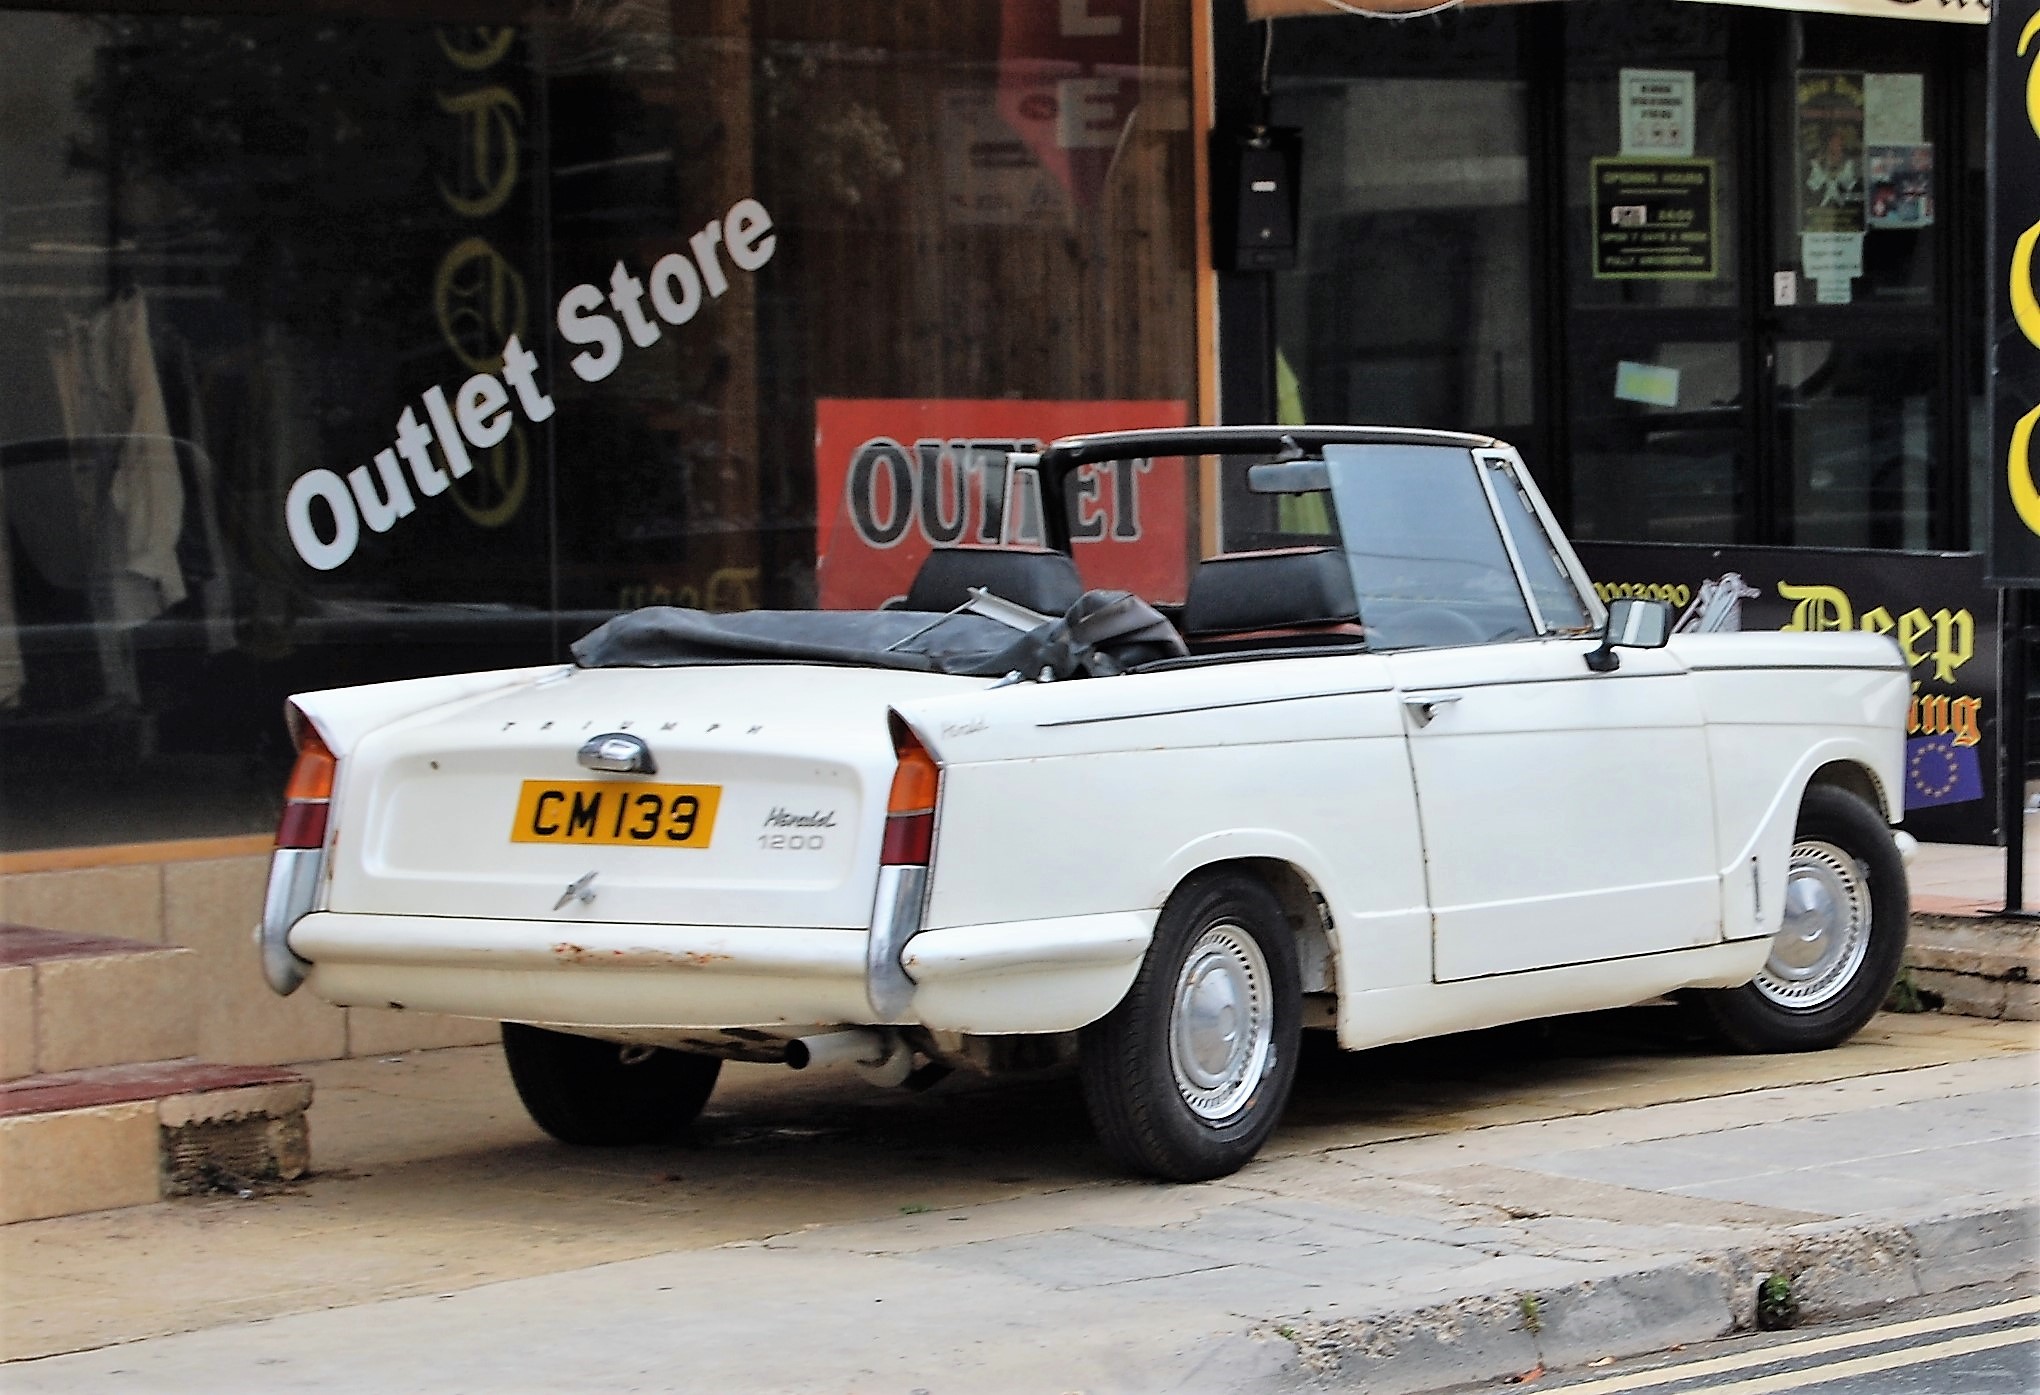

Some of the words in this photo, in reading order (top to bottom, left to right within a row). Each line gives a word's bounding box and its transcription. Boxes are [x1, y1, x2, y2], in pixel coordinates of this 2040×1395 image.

[286, 333, 556, 571] Outlet
[557, 198, 777, 382] Store
[1777, 580, 1974, 684] Deep
[501, 721, 764, 735] TRIUMPH
[532, 790, 603, 837] CM
[612, 792, 700, 841] 139
[763, 806, 837, 829] Herald
[758, 834, 825, 851] 1200
